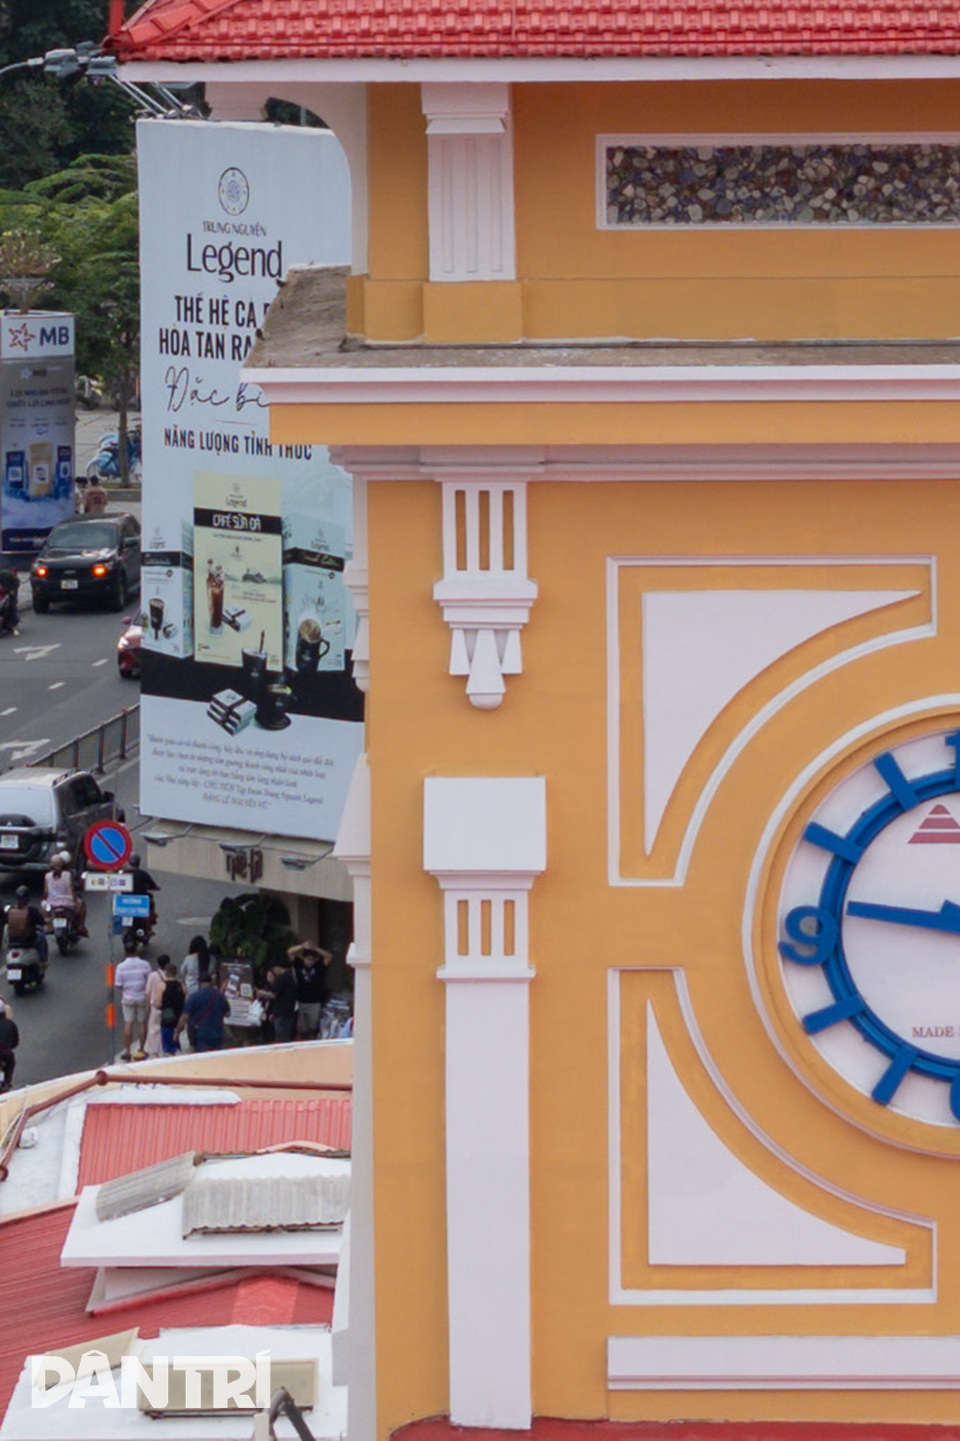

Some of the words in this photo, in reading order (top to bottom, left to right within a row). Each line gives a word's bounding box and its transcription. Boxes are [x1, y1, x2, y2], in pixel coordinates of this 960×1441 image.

[187, 232, 282, 283] Legend
[174, 292, 203, 324] THẾ
[209, 294, 230, 330] HỆ
[39, 326, 70, 346] MB
[195, 331, 225, 360] TAN
[778, 905, 839, 966] 9
[912, 1025, 954, 1038] MADE
